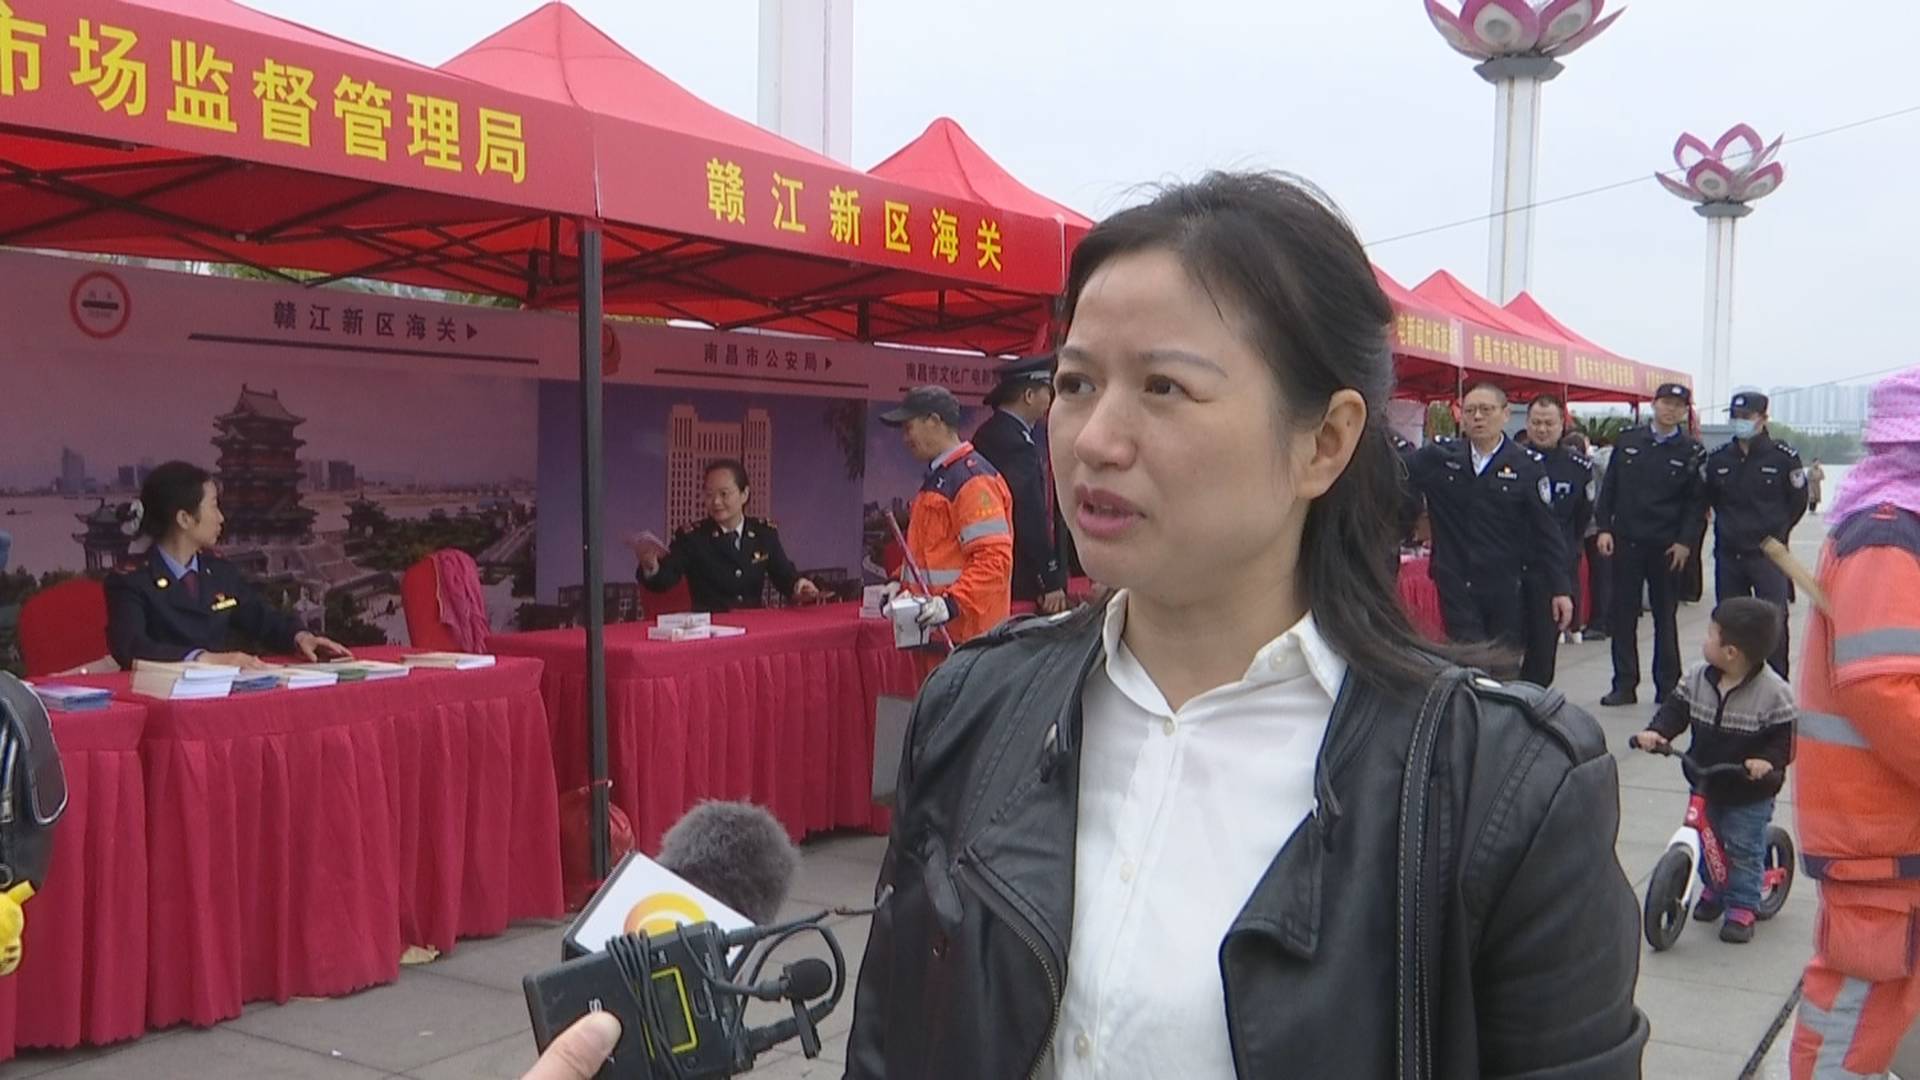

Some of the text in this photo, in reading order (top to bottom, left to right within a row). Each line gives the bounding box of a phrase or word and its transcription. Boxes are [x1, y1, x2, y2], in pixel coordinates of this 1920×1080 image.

[0, 0, 526, 183] 市场监督管理局
[706, 158, 1003, 272] 赣江新区海关
[274, 301, 457, 343] 赣江新区海关
[704, 342, 817, 372] 南昌市公安局
